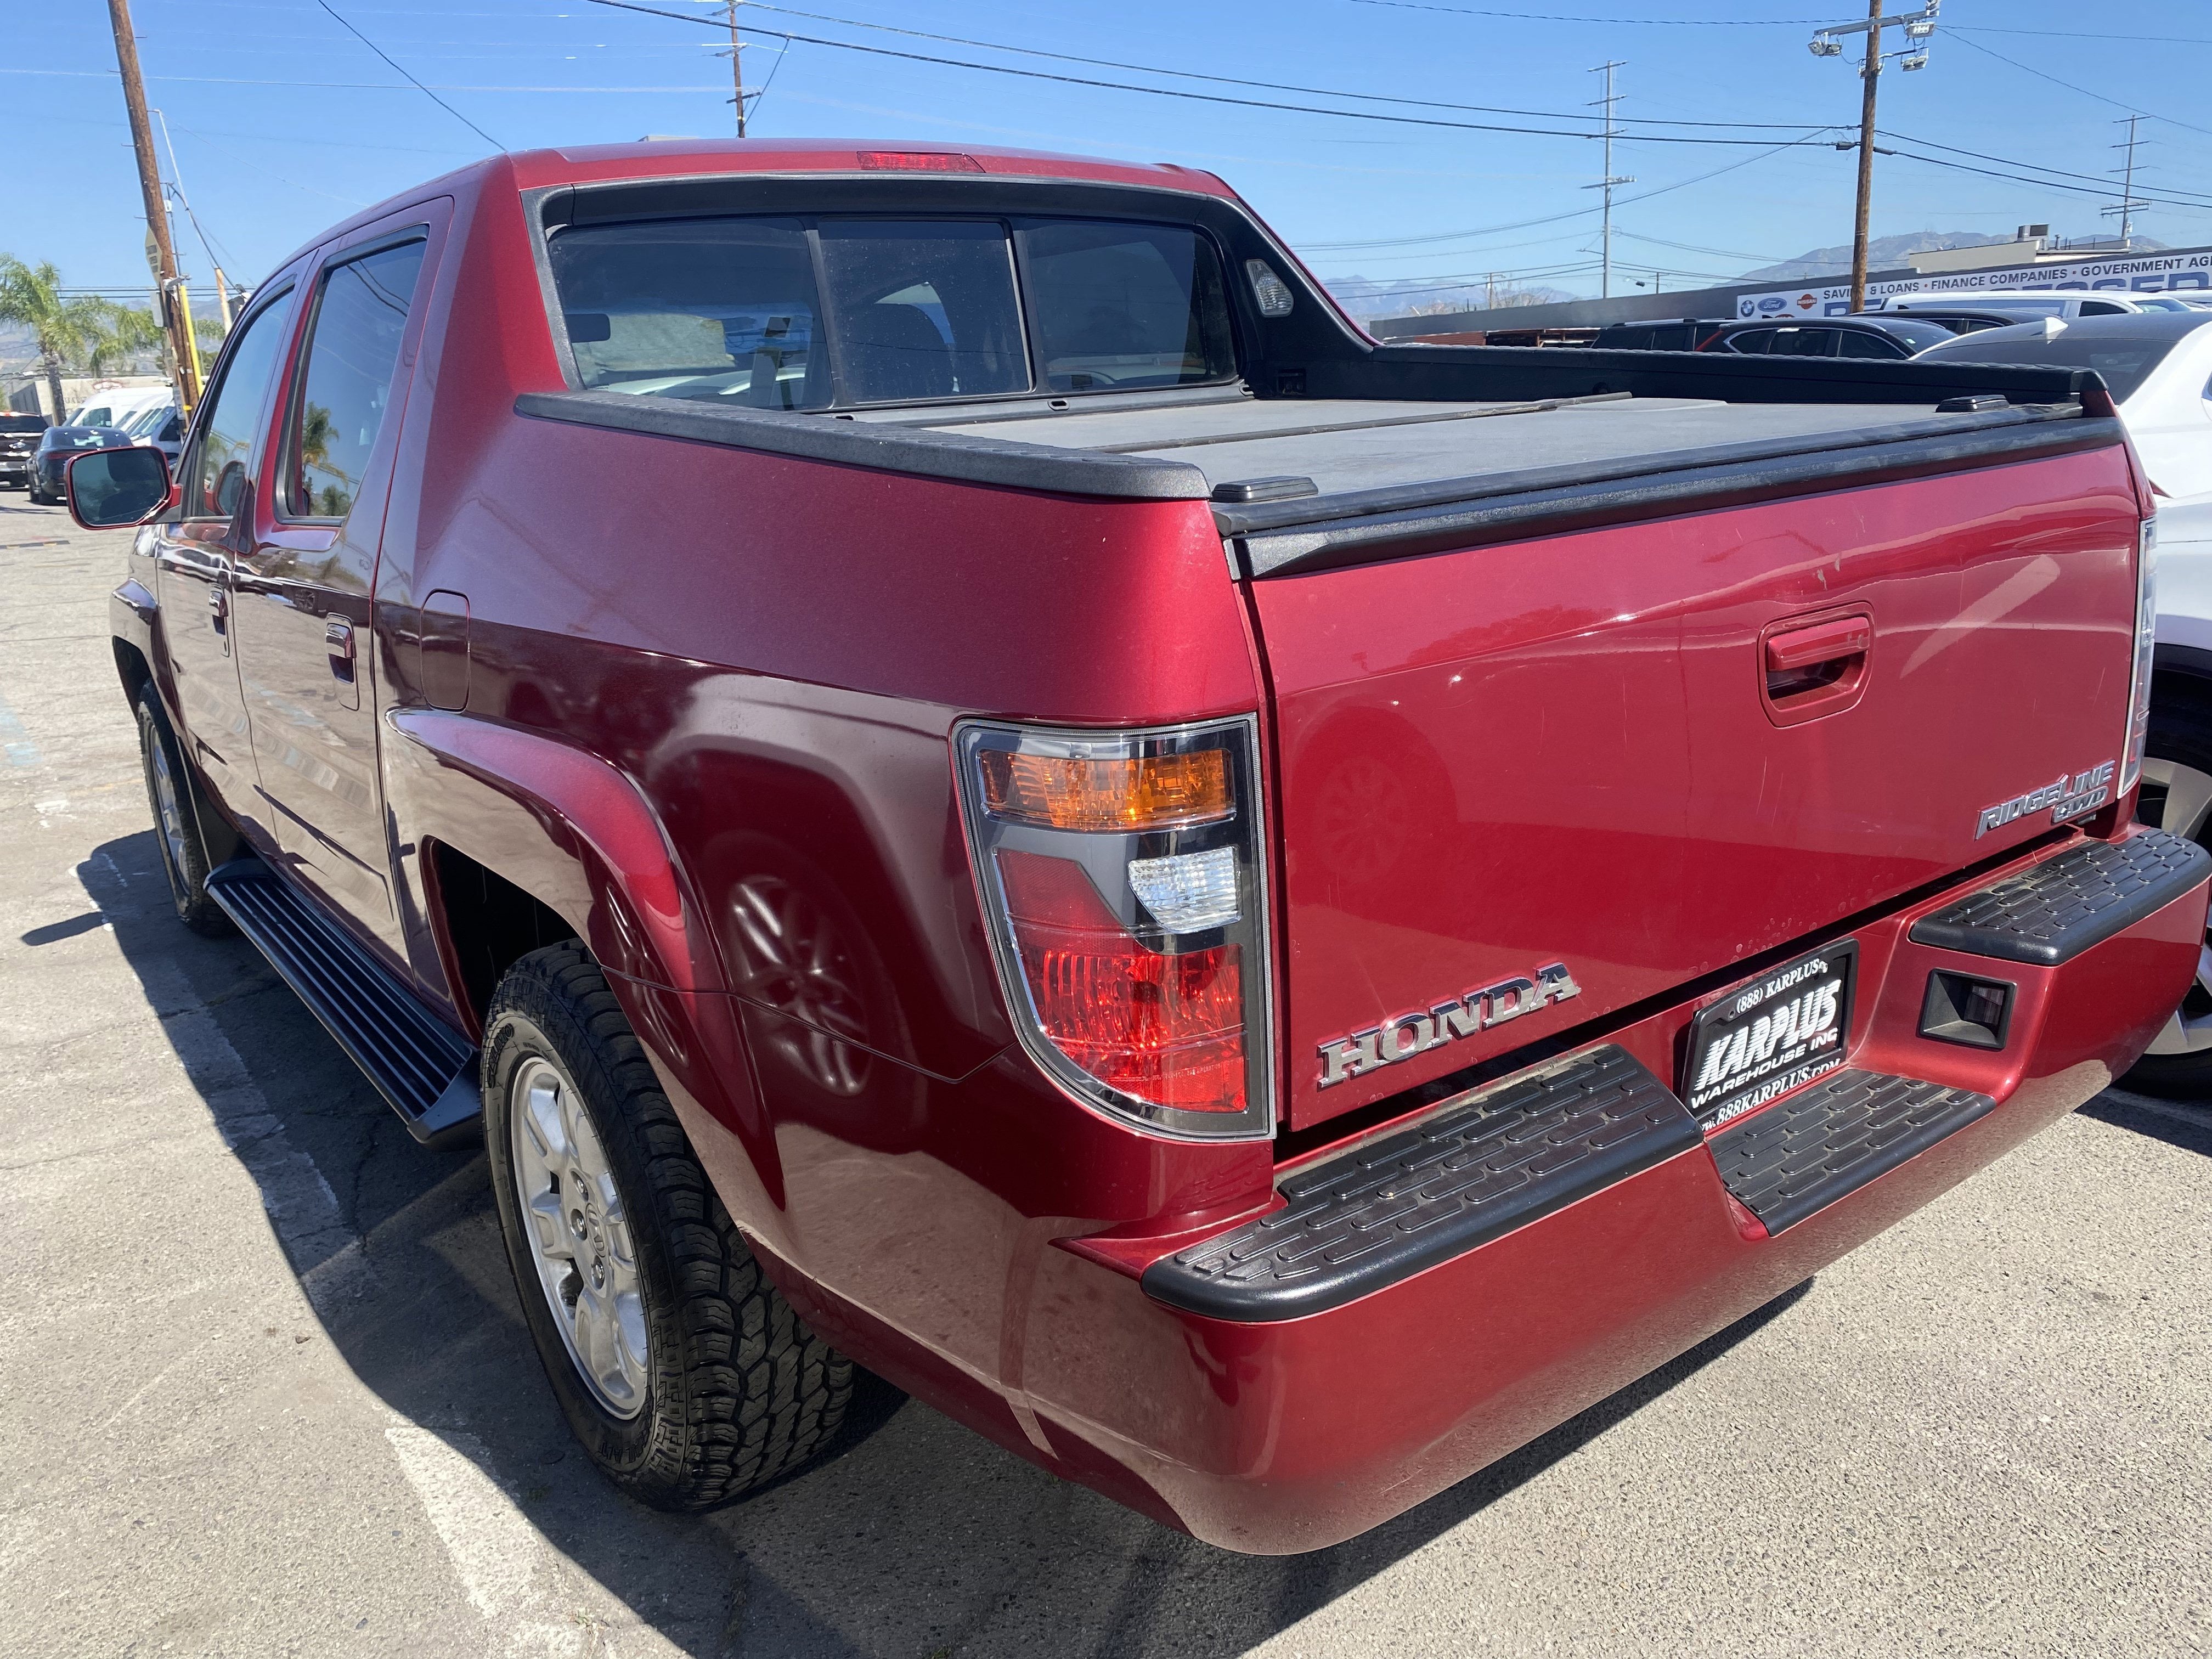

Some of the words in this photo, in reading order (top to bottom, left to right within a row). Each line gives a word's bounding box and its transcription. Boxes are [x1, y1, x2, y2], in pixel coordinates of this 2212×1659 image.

[1870, 285, 1876, 295] &
[1880, 282, 1920, 294] LOANS
[1931, 276, 1985, 290] FINANCE
[1990, 269, 2068, 285] COMPANIES
[2081, 258, 2183, 276] GOVERNMENT
[1975, 760, 2115, 840] RIDGELINE
[2056, 789, 2107, 820] 4WD
[1317, 962, 1582, 1088] HONDA
[1736, 988, 1764, 1014] (888)
[1765, 958, 1820, 999] KARPLUS
[1691, 1043, 1807, 1109] WAREHOUSE
[1810, 1028, 1838, 1051] INC
[1694, 979, 1842, 1091] KARPLUS
